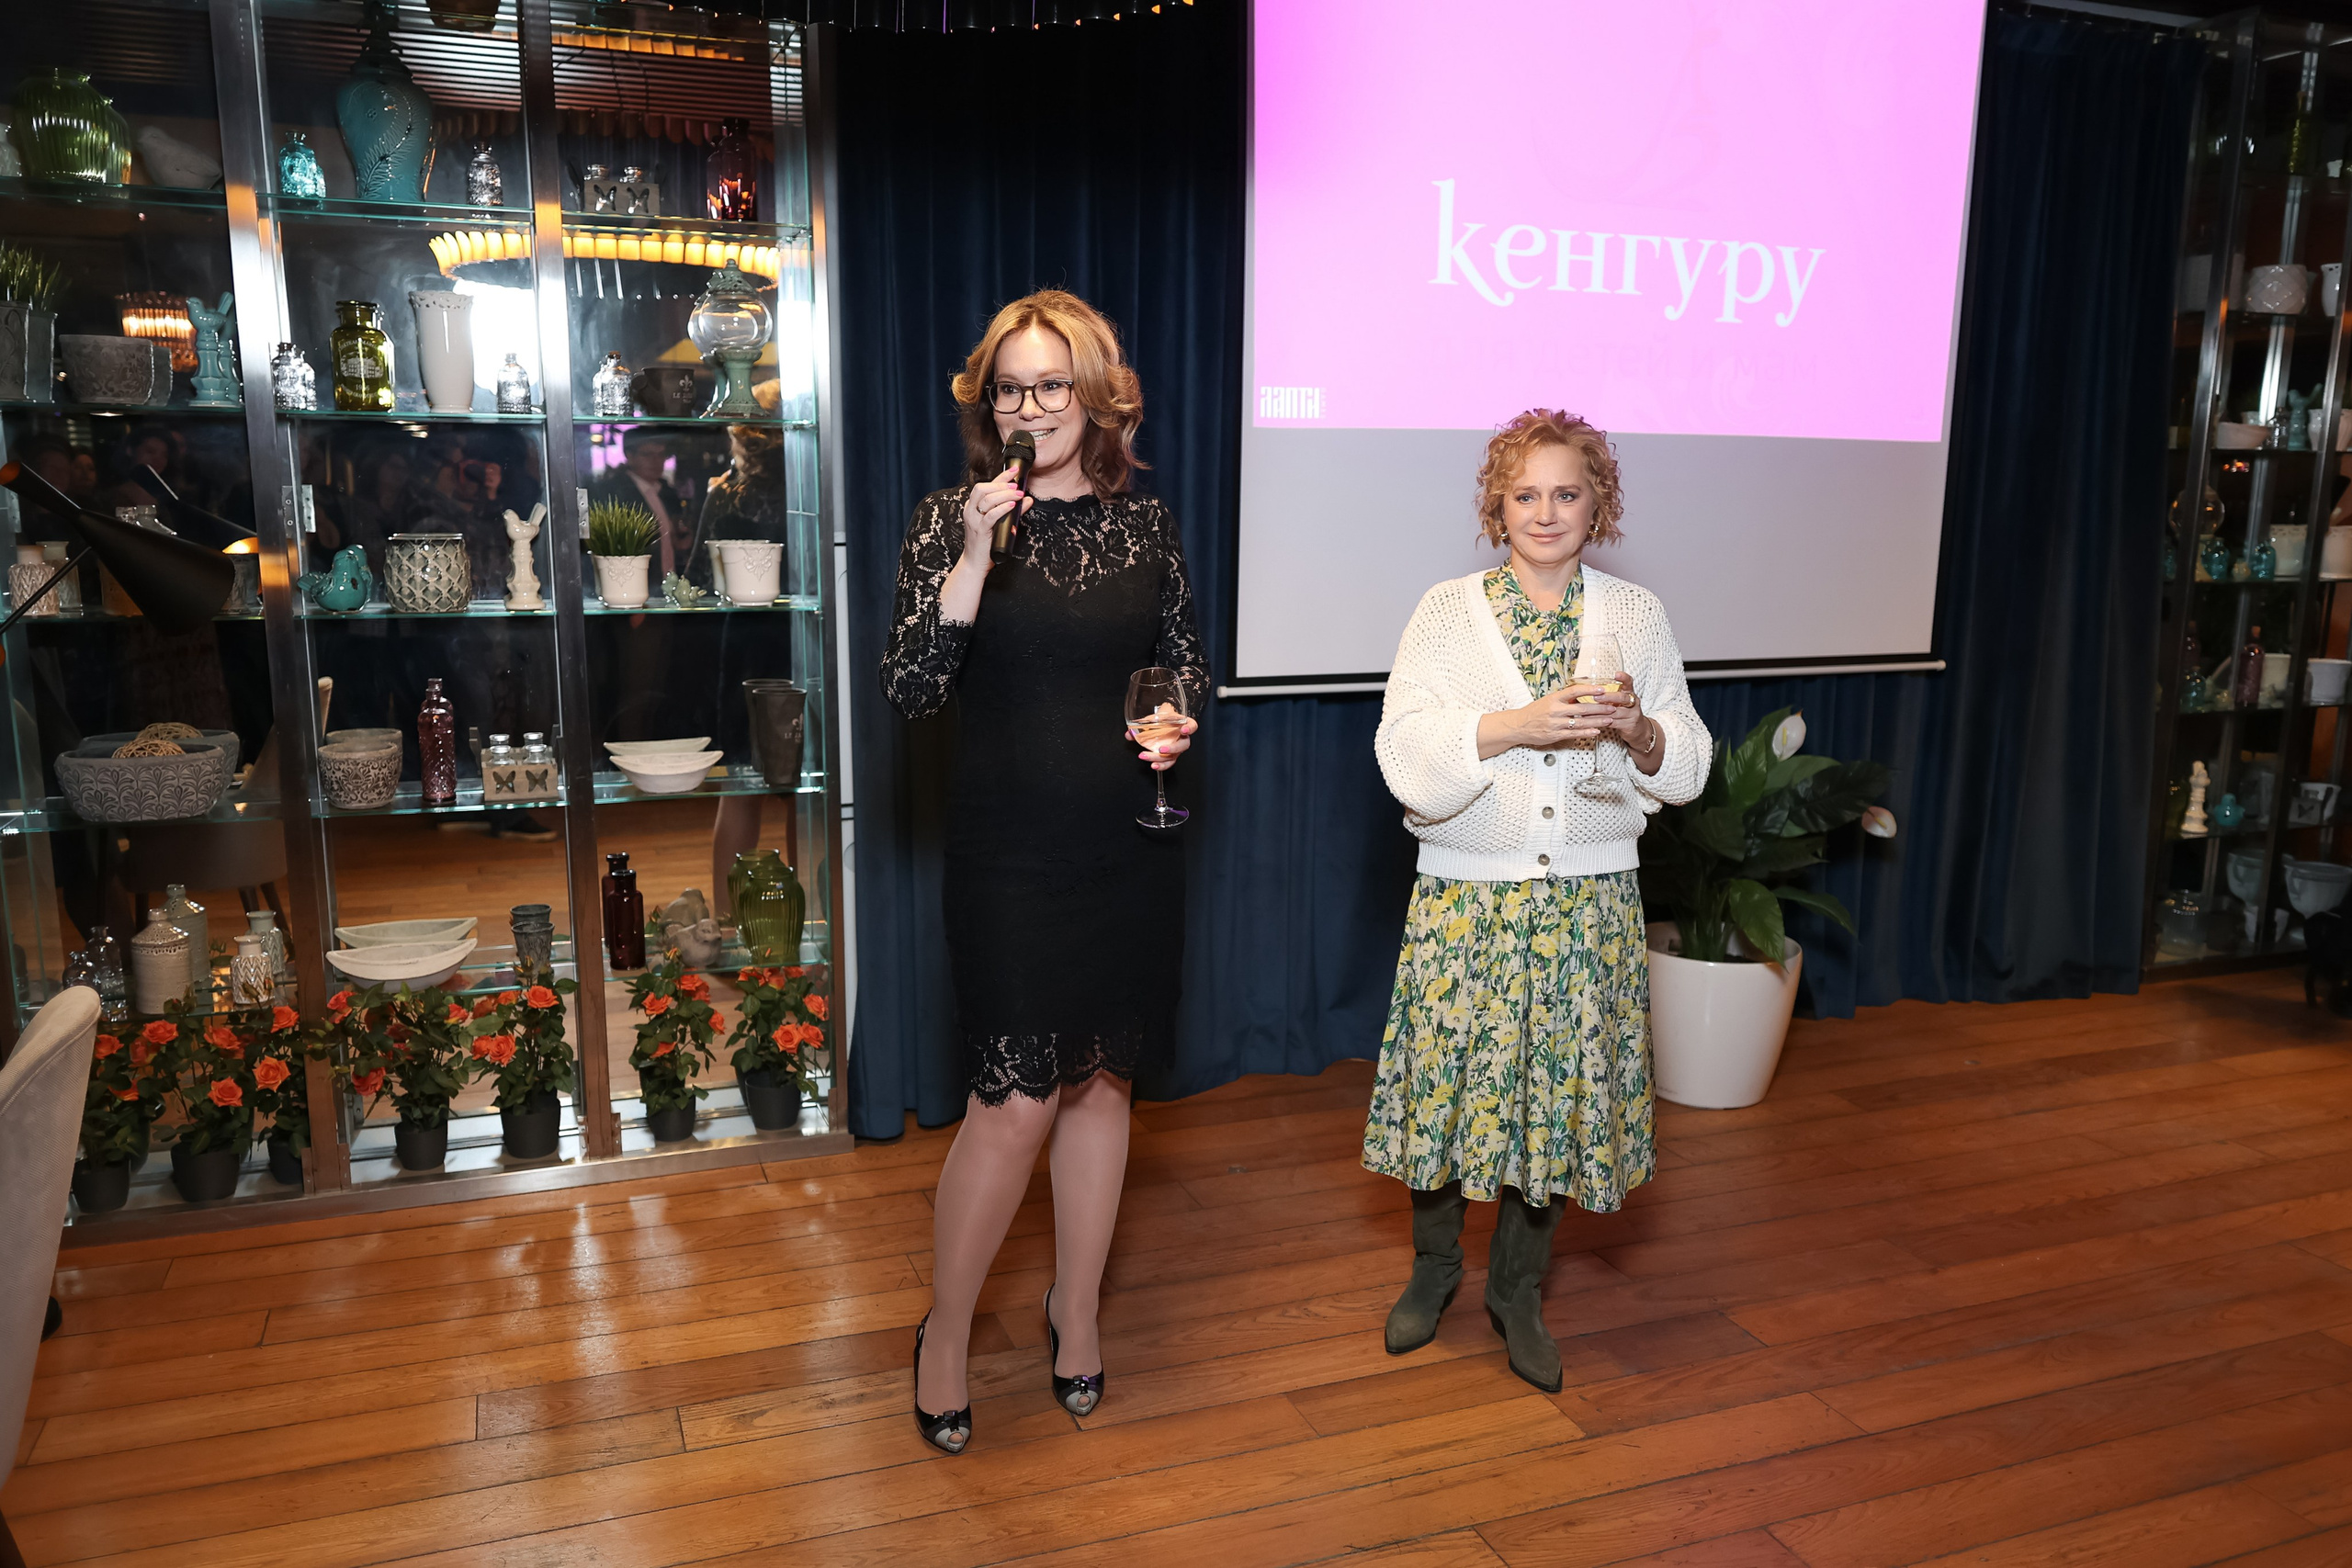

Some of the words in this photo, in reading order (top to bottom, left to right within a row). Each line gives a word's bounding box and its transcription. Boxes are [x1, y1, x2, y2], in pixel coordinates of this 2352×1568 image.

[1533, 332, 1671, 382] детей
[1691, 347, 1713, 378] и
[1732, 349, 1818, 385] мам
